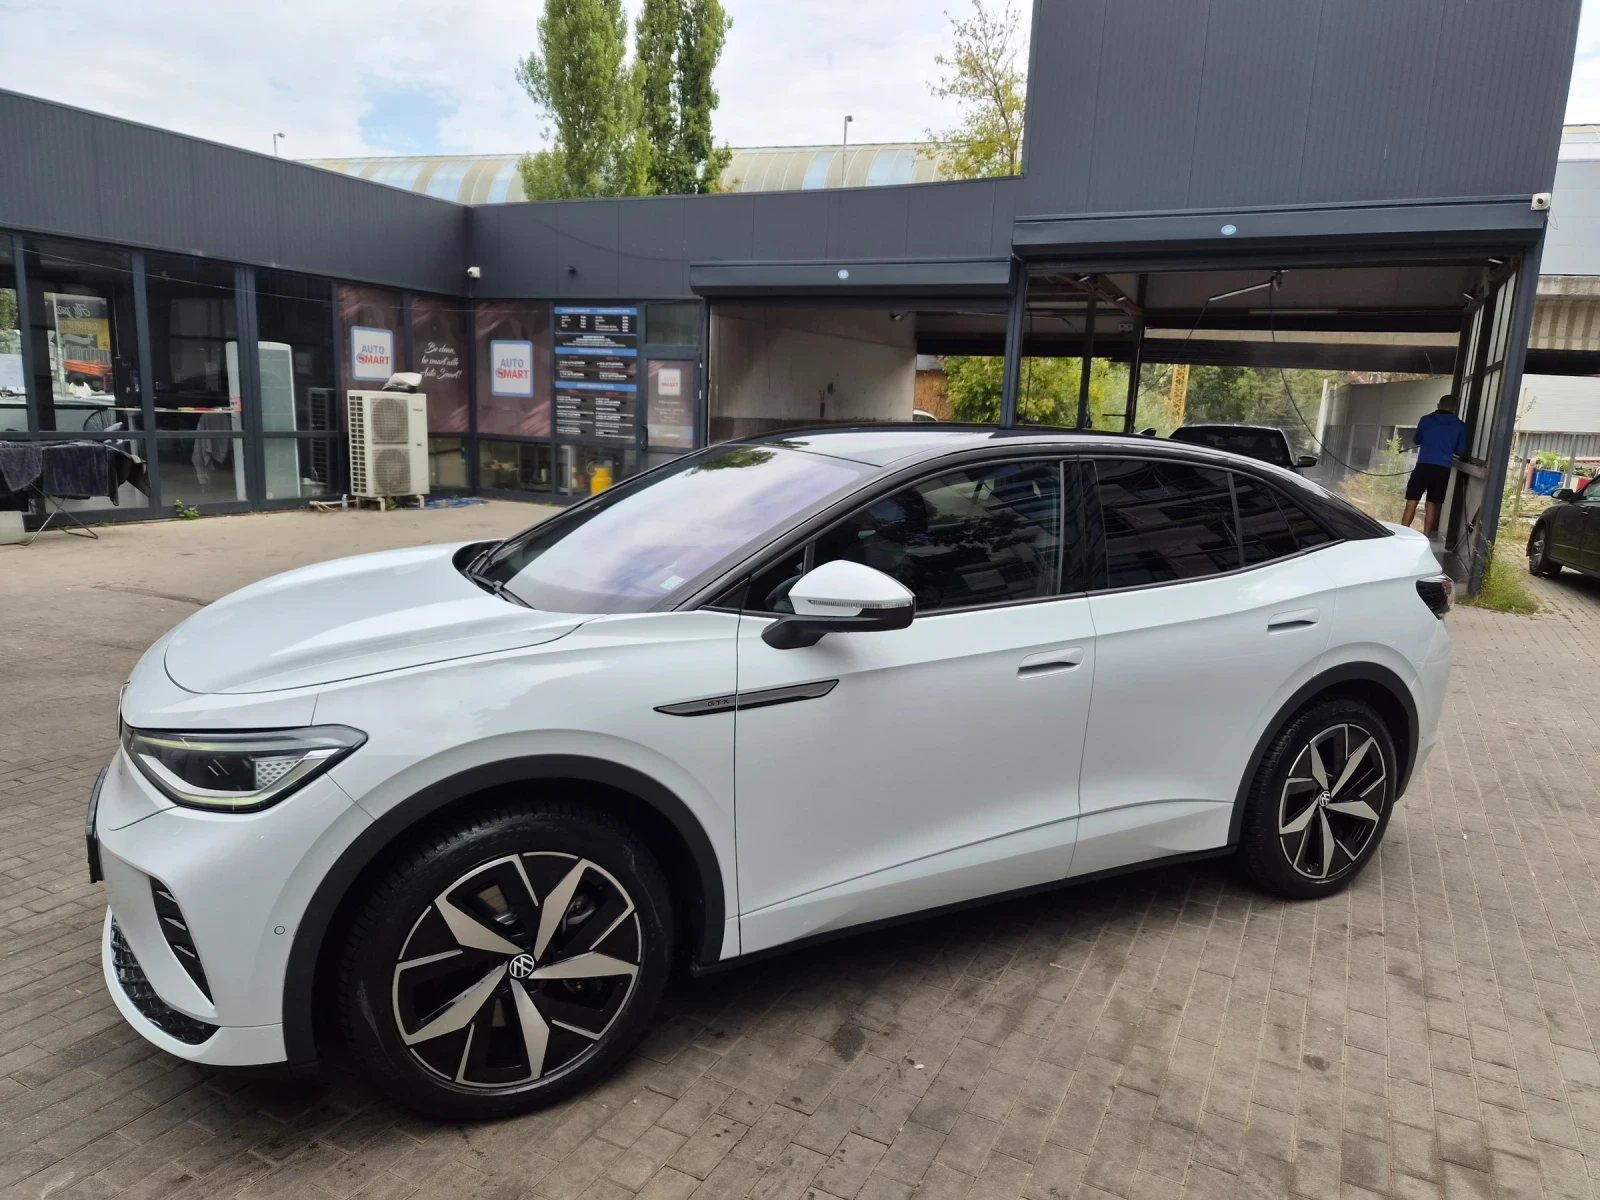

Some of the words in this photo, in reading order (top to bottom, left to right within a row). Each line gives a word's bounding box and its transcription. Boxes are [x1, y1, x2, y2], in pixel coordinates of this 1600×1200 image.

[361, 344, 385, 354] AUTO
[424, 341, 438, 354] Be
[356, 353, 390, 365] SMART
[421, 354, 429, 364] be
[428, 356, 448, 365] smart
[446, 357, 459, 366] with
[500, 358, 524, 368] AUTO
[420, 366, 437, 378] Auto
[495, 367, 530, 379] SMART
[707, 698, 730, 707] GTX
